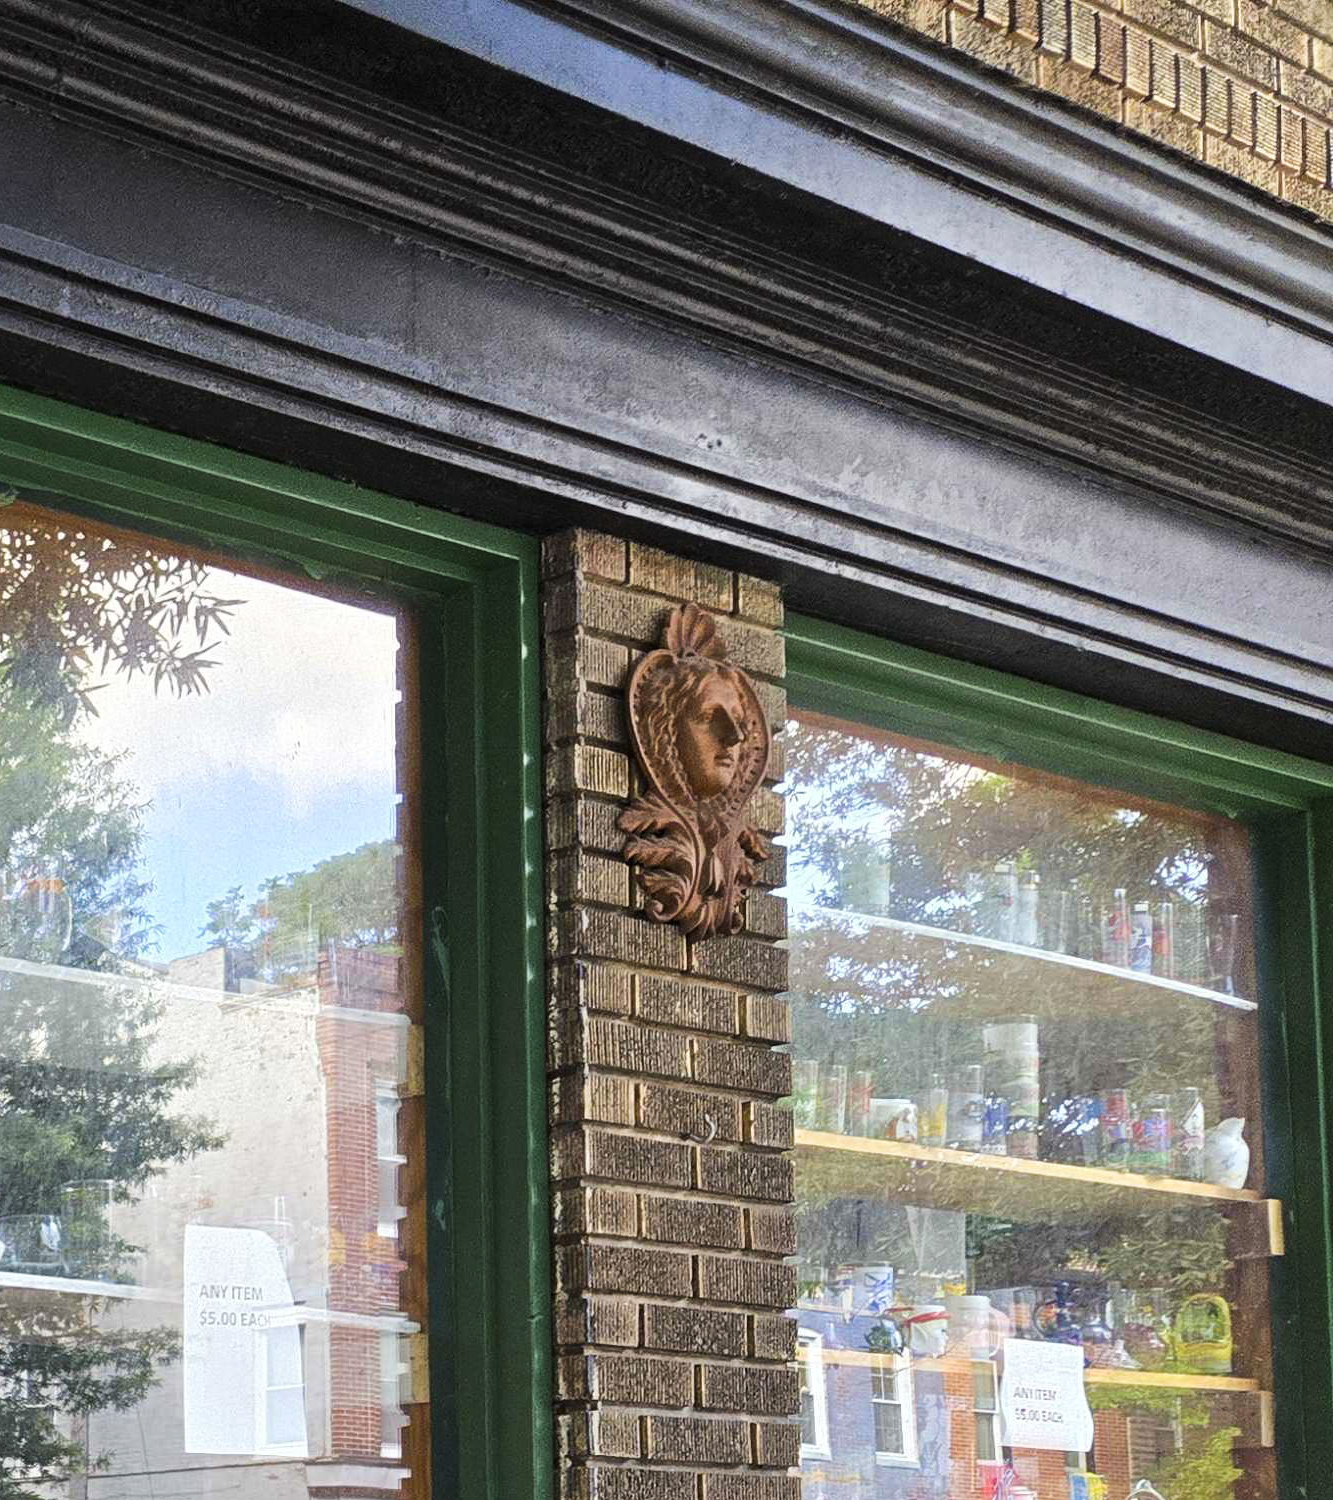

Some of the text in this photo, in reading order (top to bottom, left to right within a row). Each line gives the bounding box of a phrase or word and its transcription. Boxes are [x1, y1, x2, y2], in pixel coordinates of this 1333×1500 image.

[199, 1284, 263, 1301] ANY ITEM
[199, 1309, 237, 1326] $5.00
